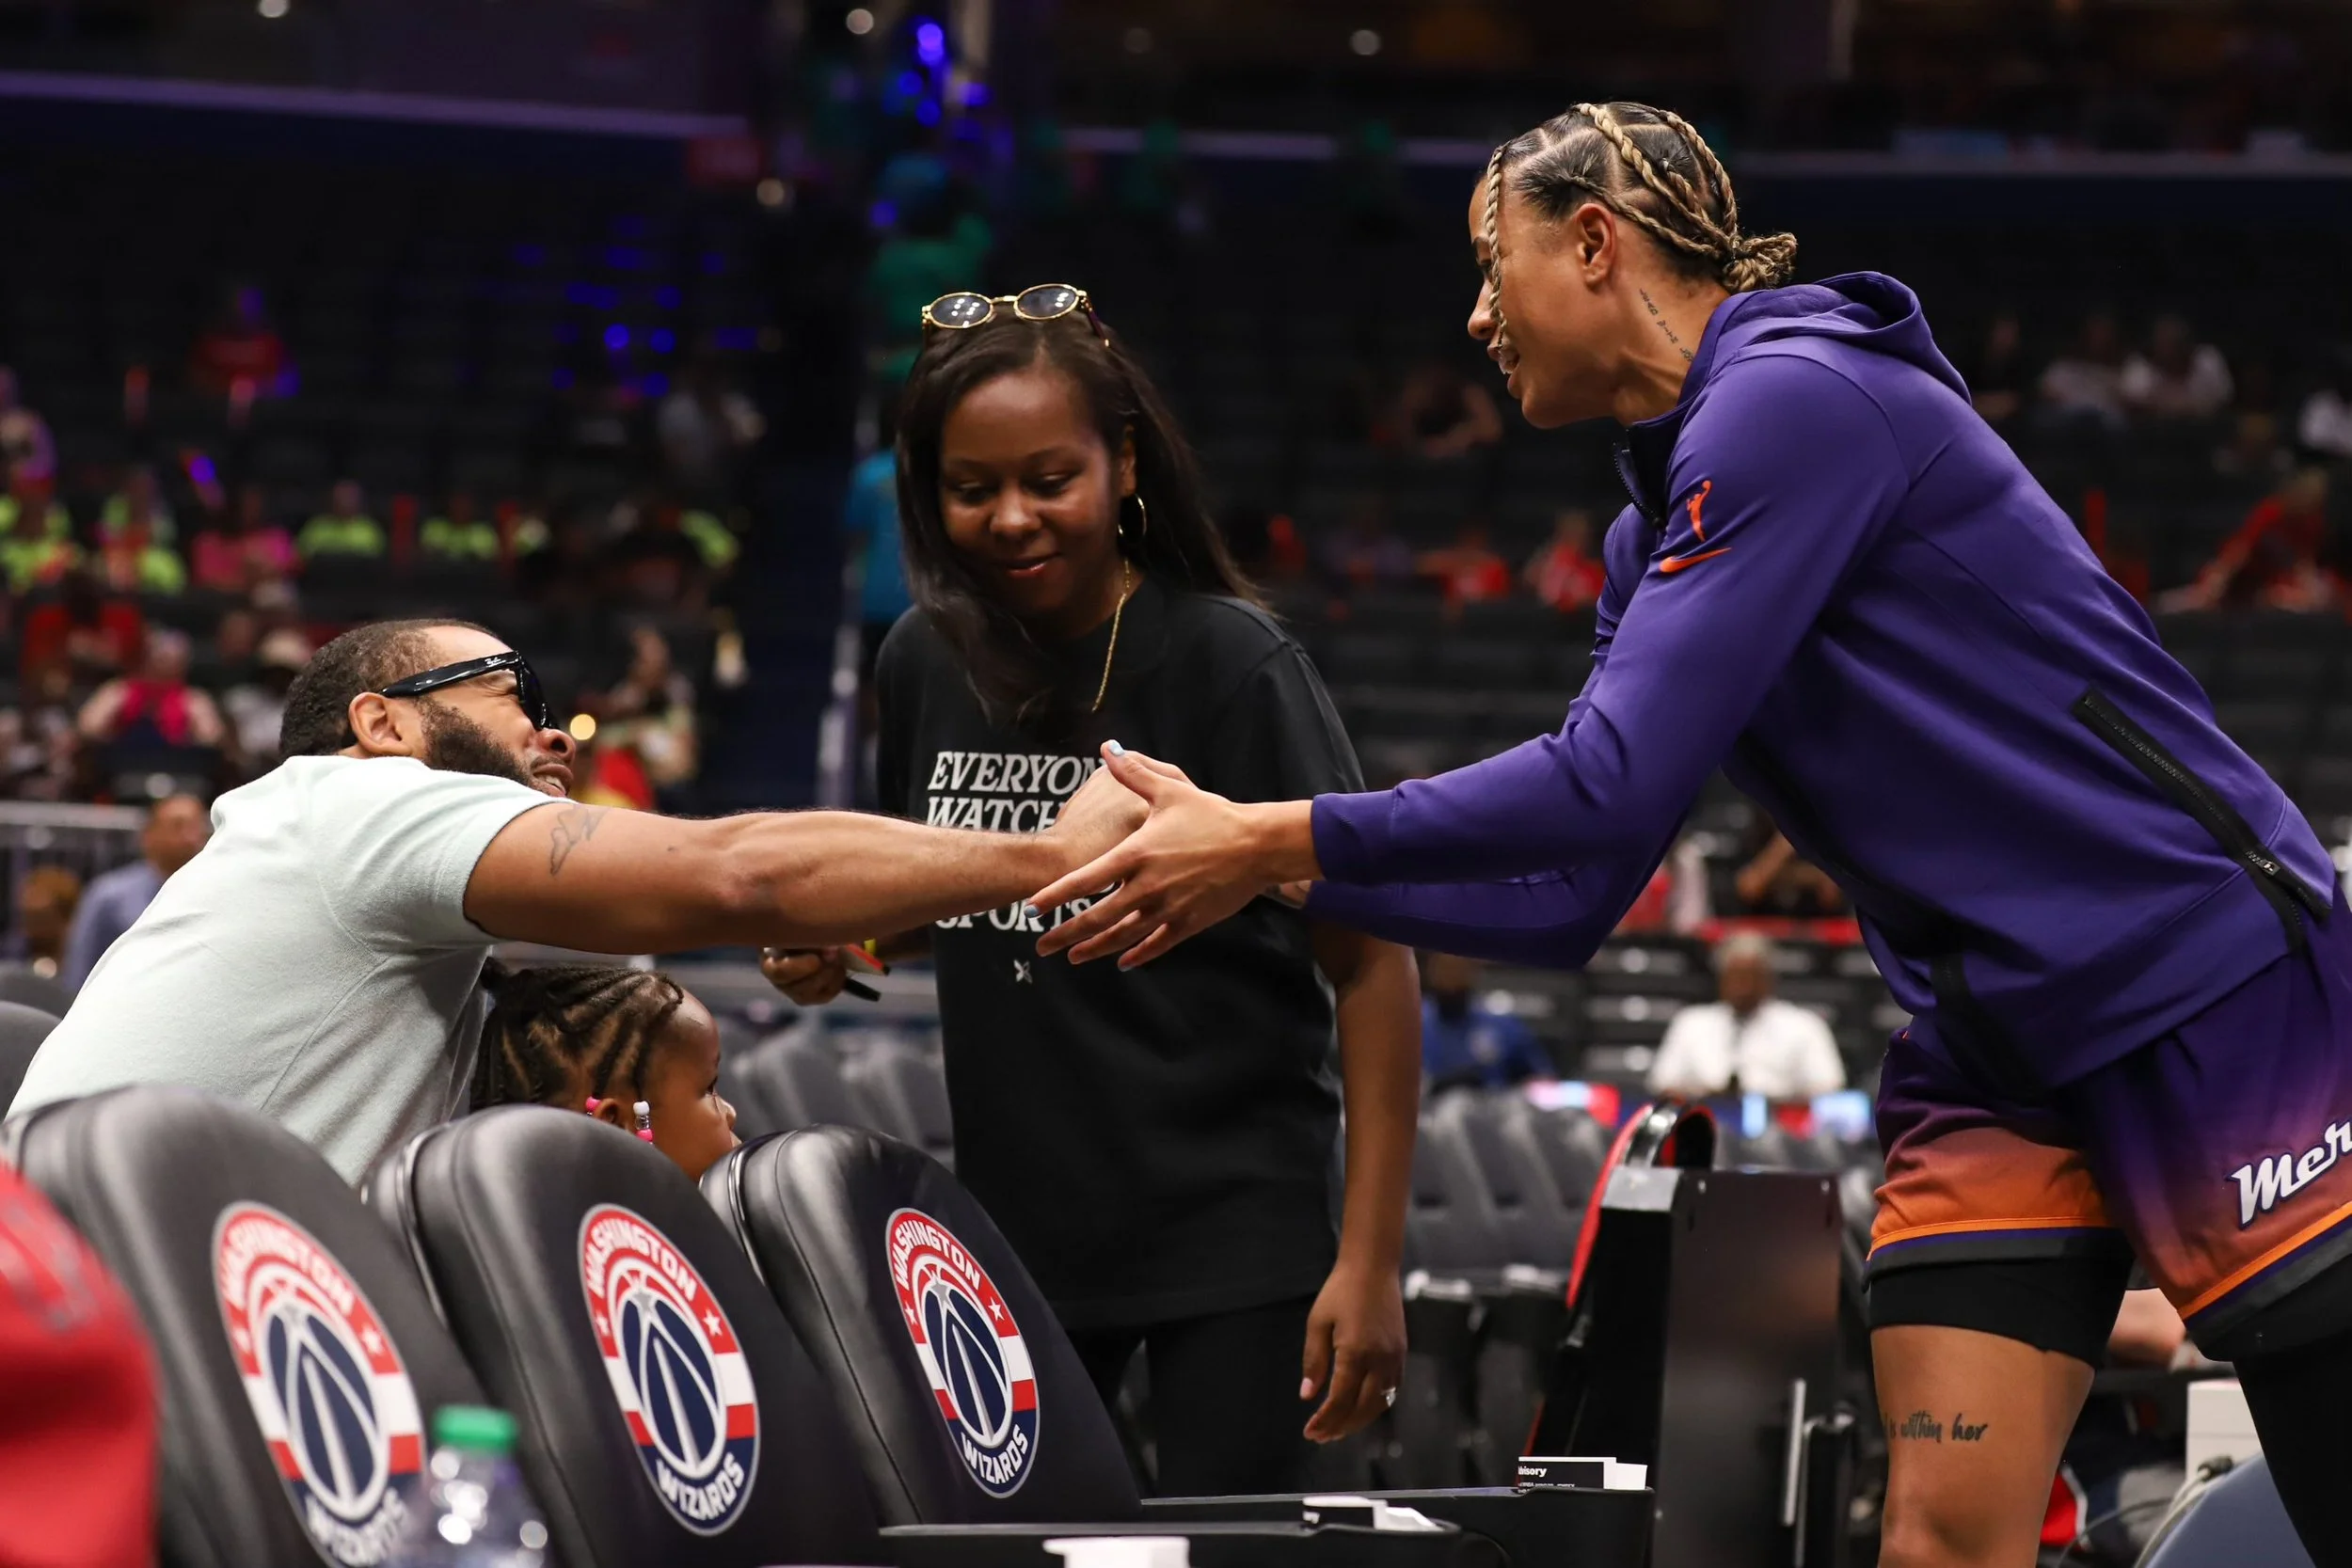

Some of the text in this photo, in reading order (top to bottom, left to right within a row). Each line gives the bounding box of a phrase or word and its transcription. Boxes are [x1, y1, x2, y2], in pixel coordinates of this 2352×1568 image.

[585, 1217, 698, 1302] WASHINGTON
[893, 1220, 982, 1291] WASHINGTON
[960, 1423, 1029, 1485] WIZARDS
[1951, 1412, 1988, 1442] her
[656, 1451, 746, 1522] WIZARDS
